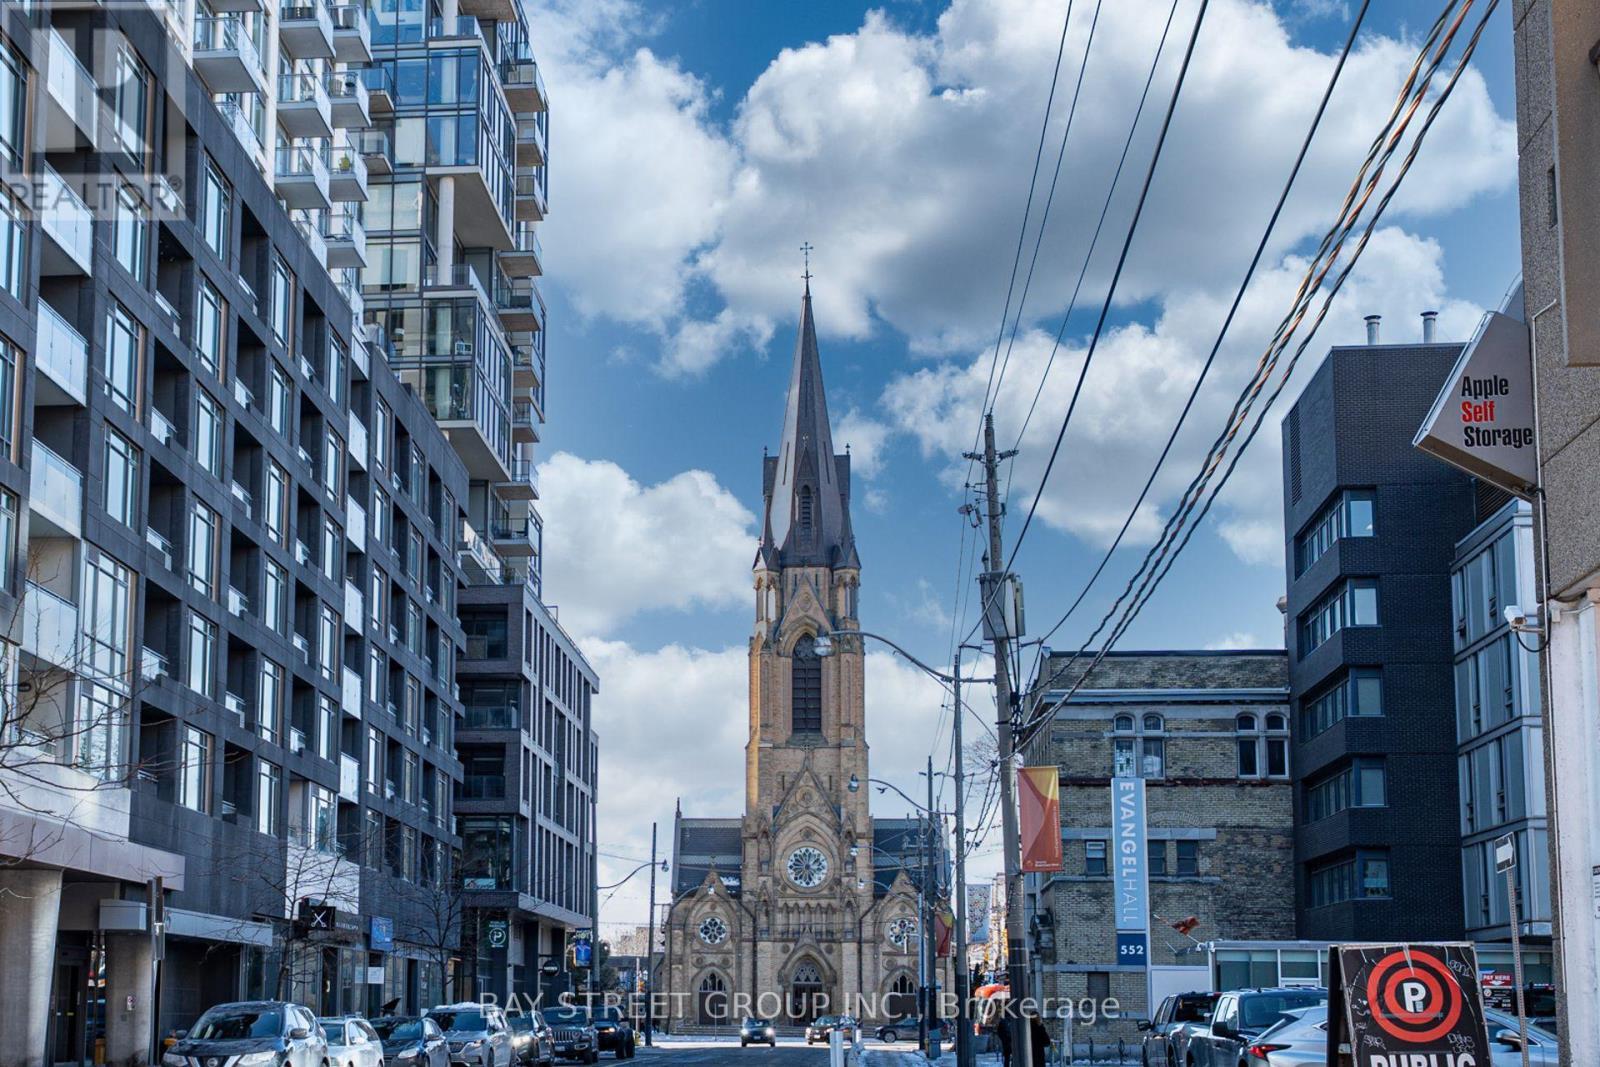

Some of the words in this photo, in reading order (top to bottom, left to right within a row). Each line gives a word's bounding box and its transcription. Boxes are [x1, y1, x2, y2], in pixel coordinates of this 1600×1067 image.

[1461, 375, 1509, 400] Apple
[1461, 401, 1495, 423] Self
[1464, 426, 1533, 448] Storage
[1120, 944, 1144, 955] 552
